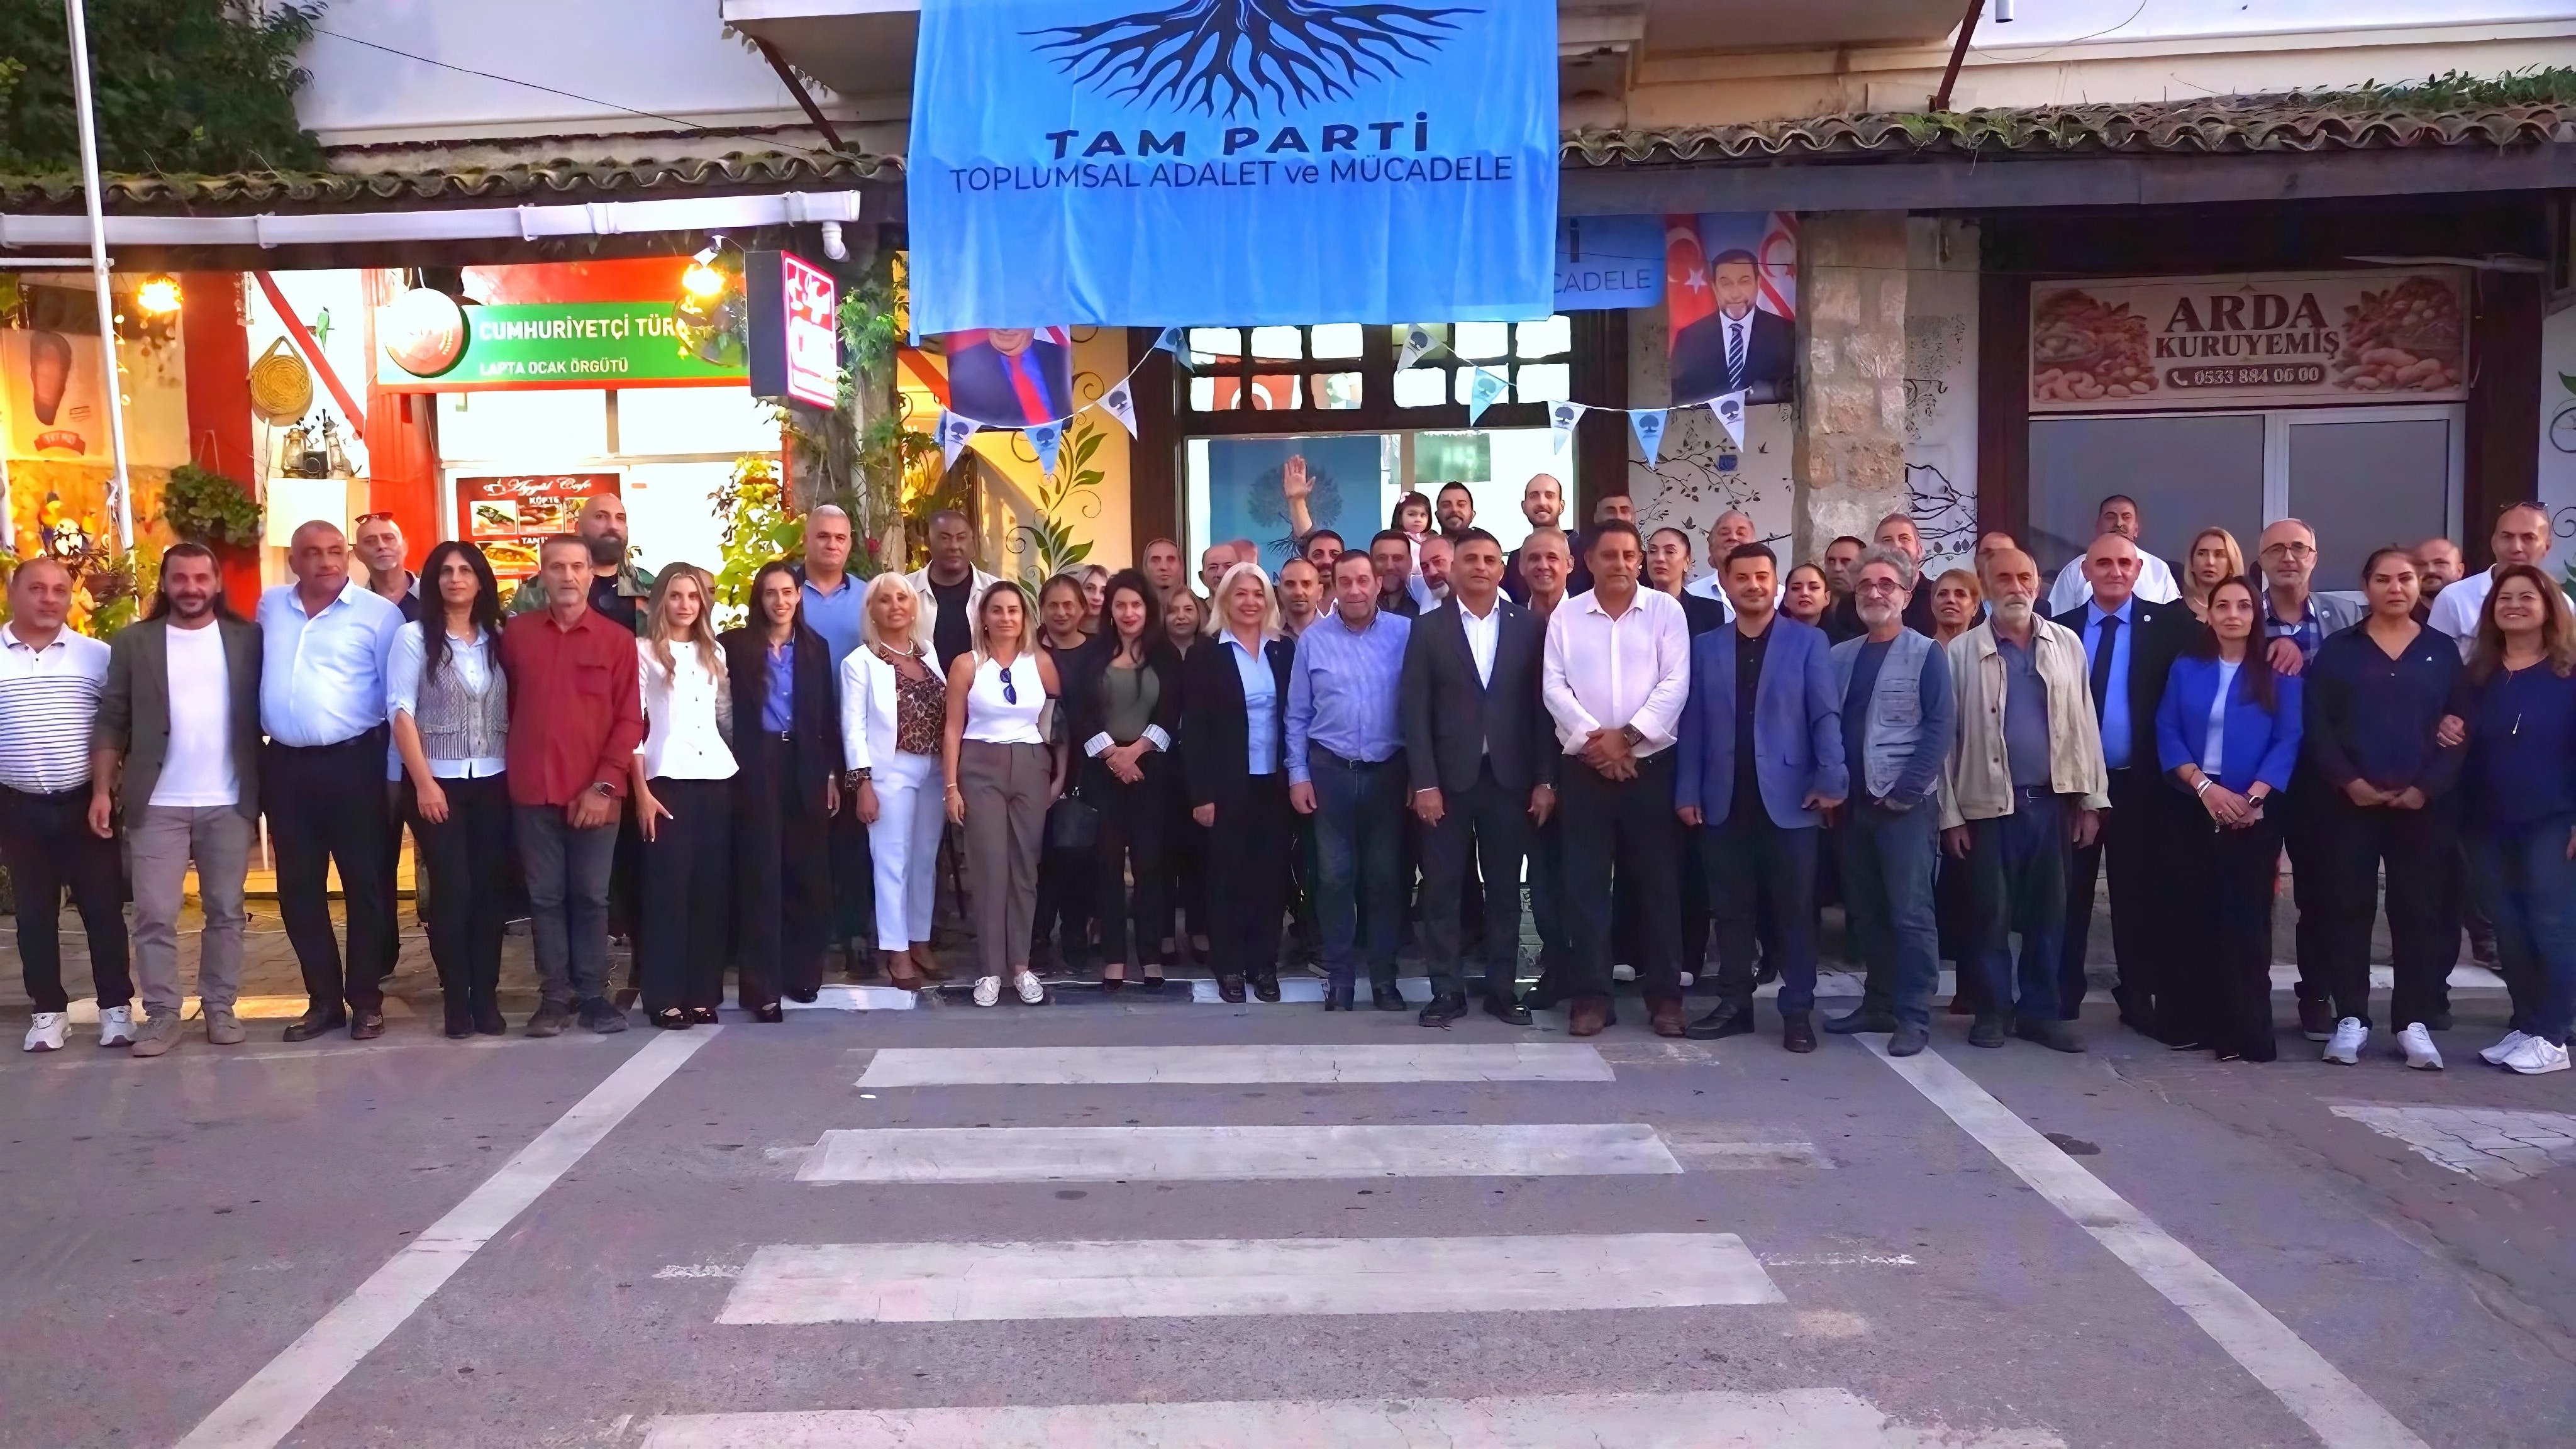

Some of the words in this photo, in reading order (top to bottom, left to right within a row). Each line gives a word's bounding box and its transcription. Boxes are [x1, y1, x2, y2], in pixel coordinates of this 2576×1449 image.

[1045, 130, 1186, 160] TAM
[1223, 111, 1428, 155] PARTİ
[950, 164, 1141, 193] TOPLUMSAL
[1149, 160, 1277, 187] ADALET
[1284, 165, 1319, 184] ve
[1331, 155, 1513, 183] MÜCADELE
[479, 313, 629, 340] CUMHURİYETÇİ
[635, 313, 679, 336] TÜR
[2163, 292, 2328, 332] ARDA
[479, 360, 525, 376] LAPTA
[528, 360, 567, 374] OCAK
[570, 357, 628, 373] ÖRGÜTÜ
[2298, 367, 2319, 381] 00
